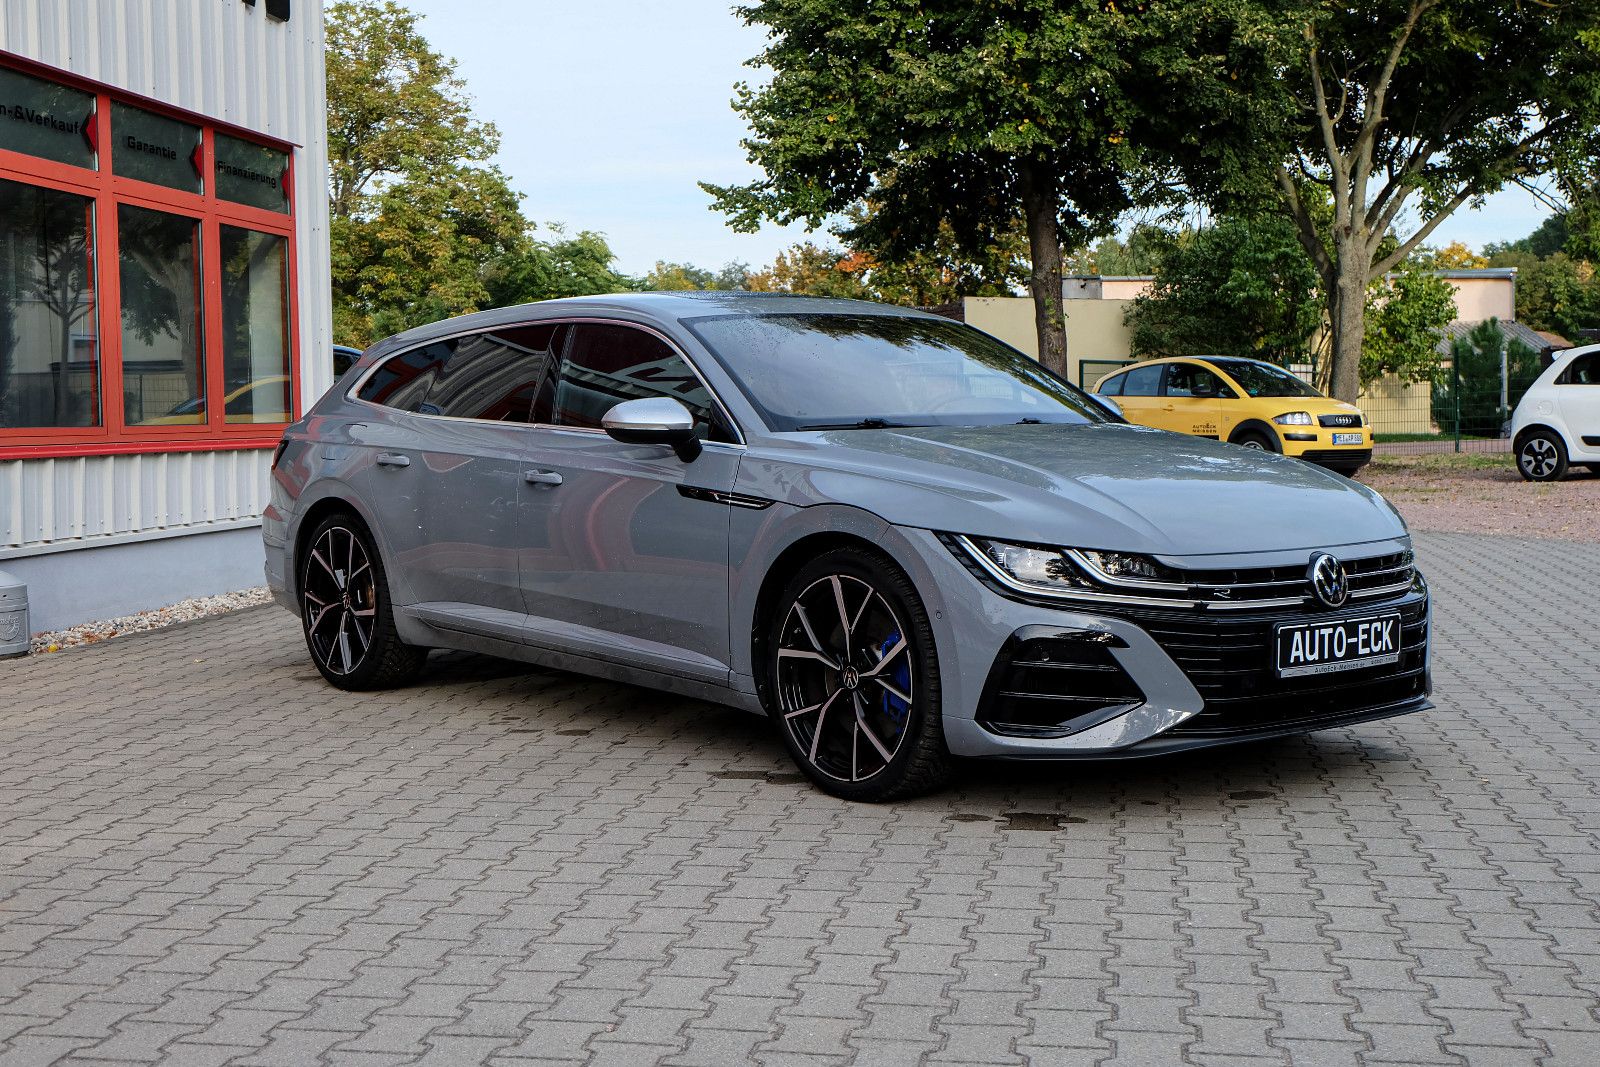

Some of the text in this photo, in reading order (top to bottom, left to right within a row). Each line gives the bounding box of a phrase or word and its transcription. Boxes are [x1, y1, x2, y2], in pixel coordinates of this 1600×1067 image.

[127, 135, 177, 160] Garantie
[217, 160, 277, 189] Finanzierung
[1289, 619, 1394, 663] AUTO-ECK
